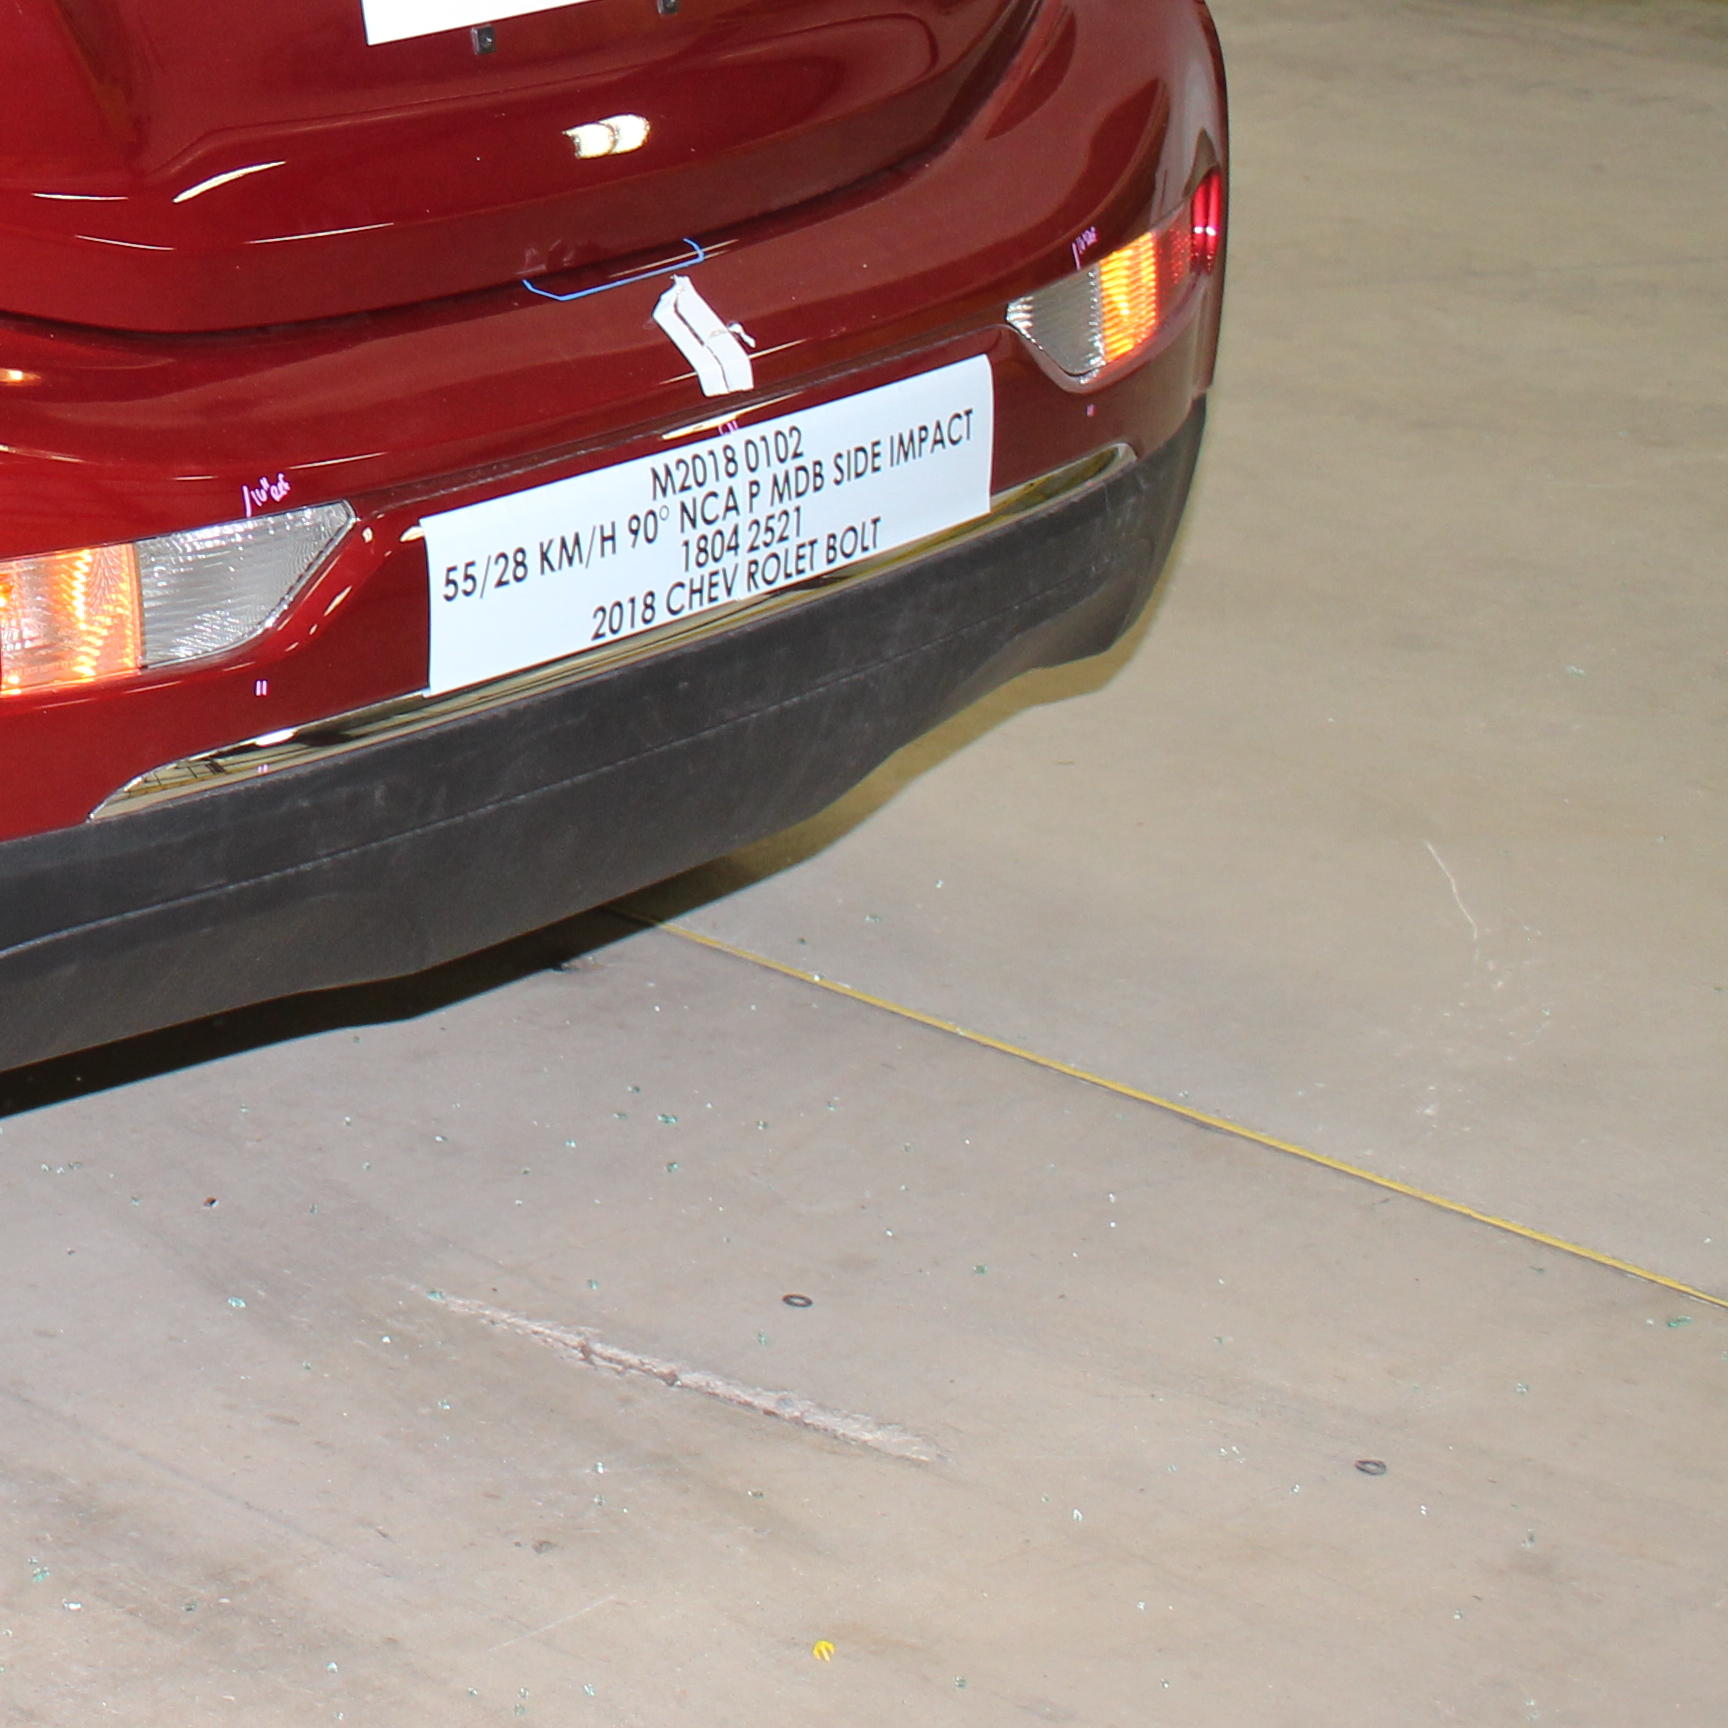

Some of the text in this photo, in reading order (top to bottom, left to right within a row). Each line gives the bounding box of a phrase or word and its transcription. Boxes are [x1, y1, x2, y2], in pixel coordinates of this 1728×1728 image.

[442, 547, 528, 602] 55/28
[538, 521, 617, 575] KM/H
[770, 459, 825, 507] MDB
[832, 439, 882, 486] SIDE
[889, 408, 974, 468] IMPACT
[591, 590, 656, 641] 2018
[825, 516, 881, 564] BOLT
